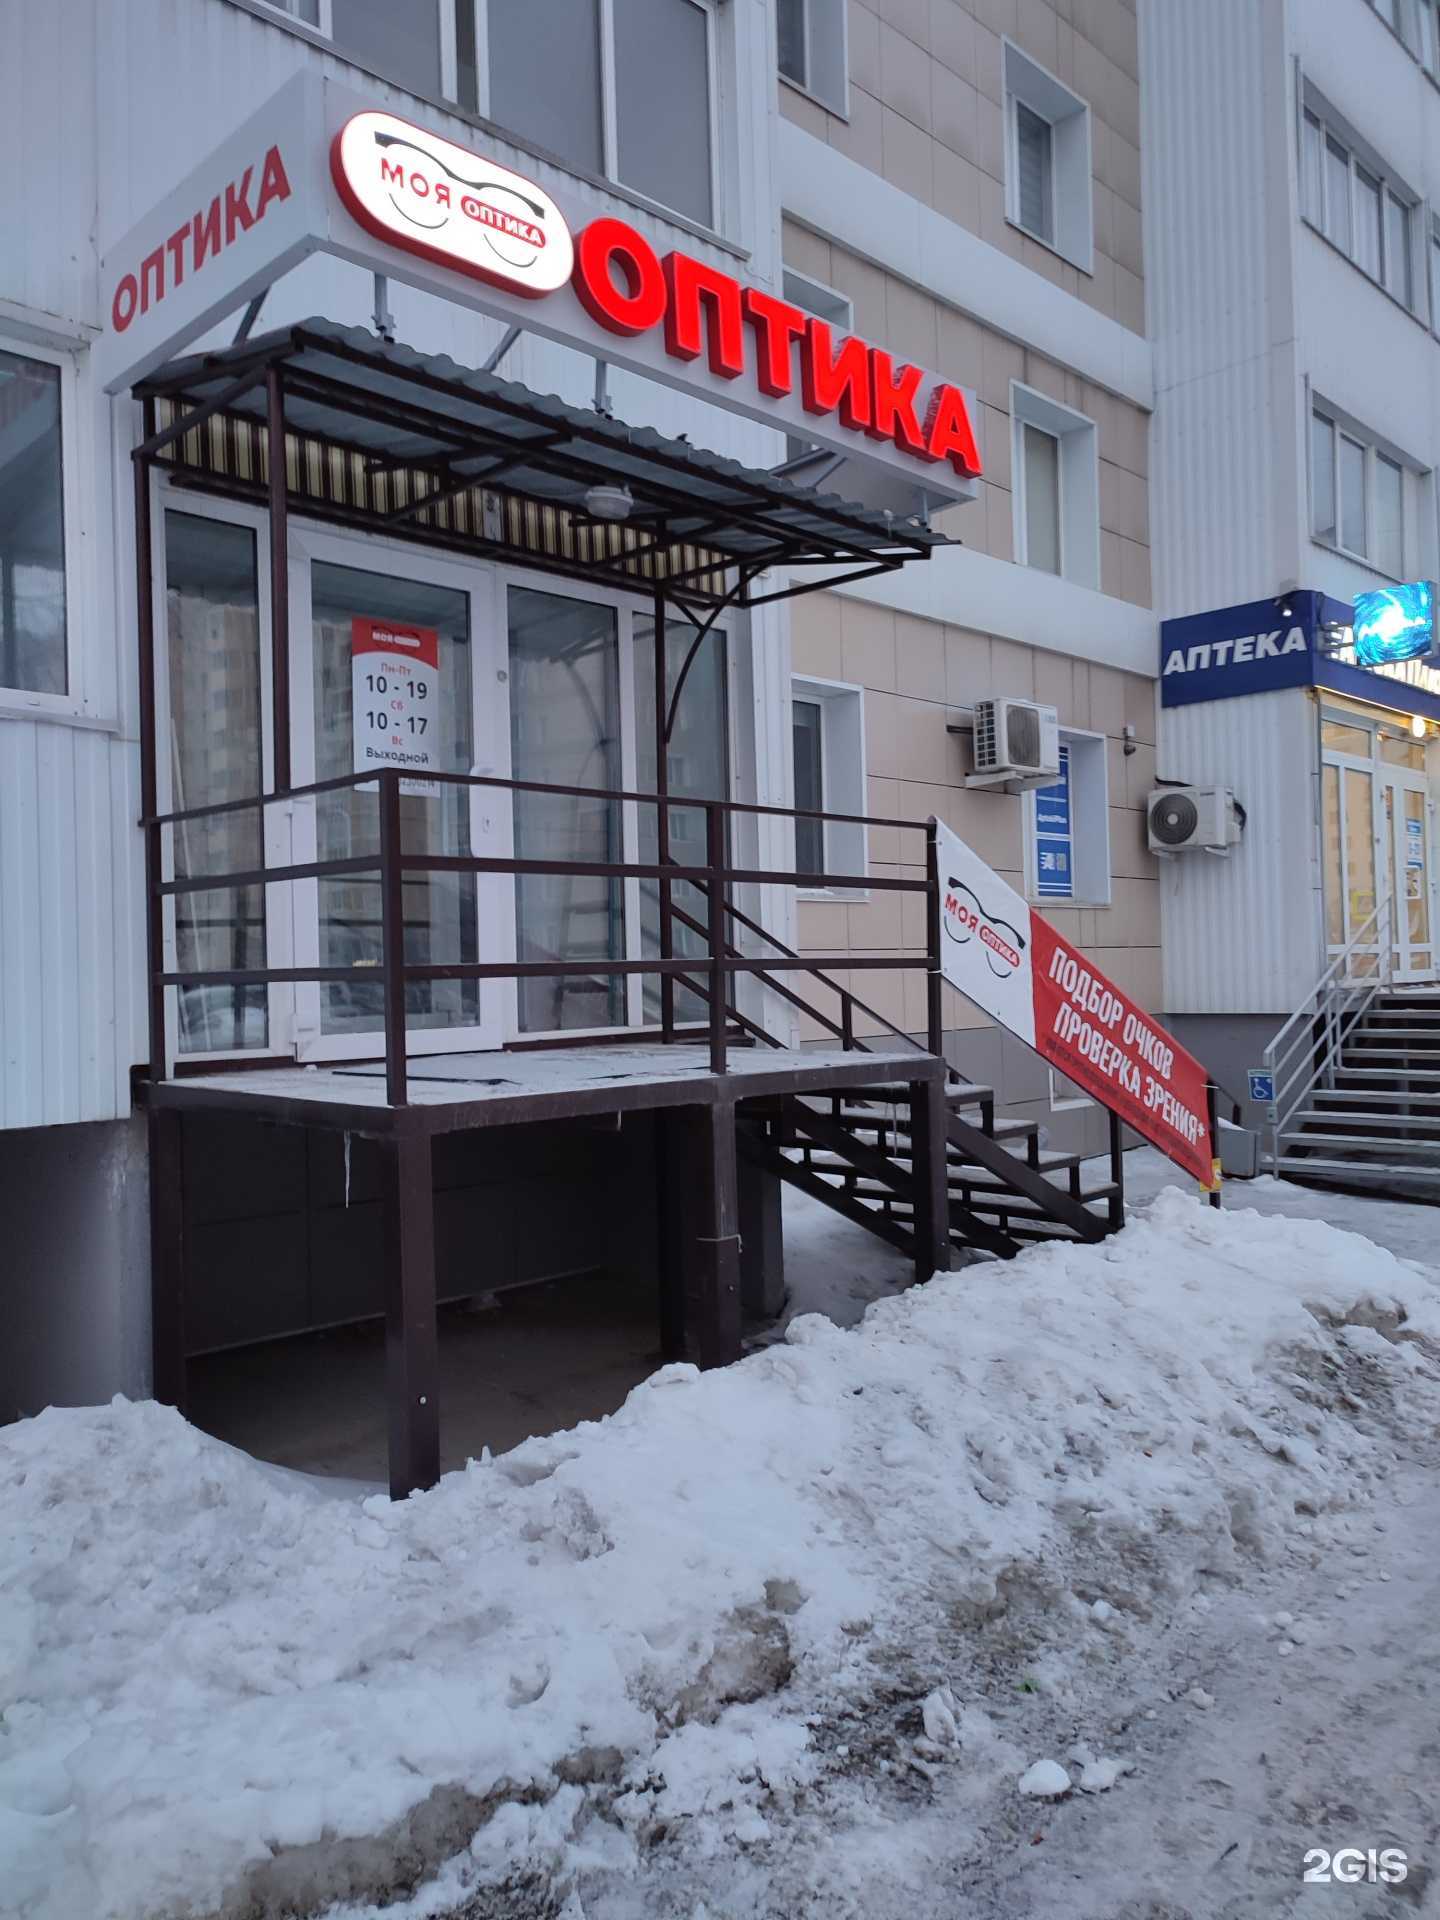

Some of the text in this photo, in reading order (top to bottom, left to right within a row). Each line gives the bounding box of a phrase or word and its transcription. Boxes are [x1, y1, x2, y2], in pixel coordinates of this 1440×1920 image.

[381, 158, 542, 246] МОЯ ОПТИКА
[111, 145, 292, 333] ОПТИКА
[572, 216, 983, 478] ОПТИКА
[381, 662, 412, 676] Пн-Пт
[1163, 626, 1307, 676] АПТЕКА
[366, 674, 388, 694] 10
[406, 681, 428, 699] 19
[390, 700, 404, 711] Сб
[366, 711, 388, 730] 10
[407, 717, 428, 735] 17
[391, 735, 404, 746] Вс
[366, 746, 429, 765] Выходной
[944, 893, 1019, 967] МОЯ ОПТИКА
[1048, 947, 1175, 1081] ПОДБОР ОЧКОВ
[1053, 1001, 1142, 1099] ПРОВЕРКА
